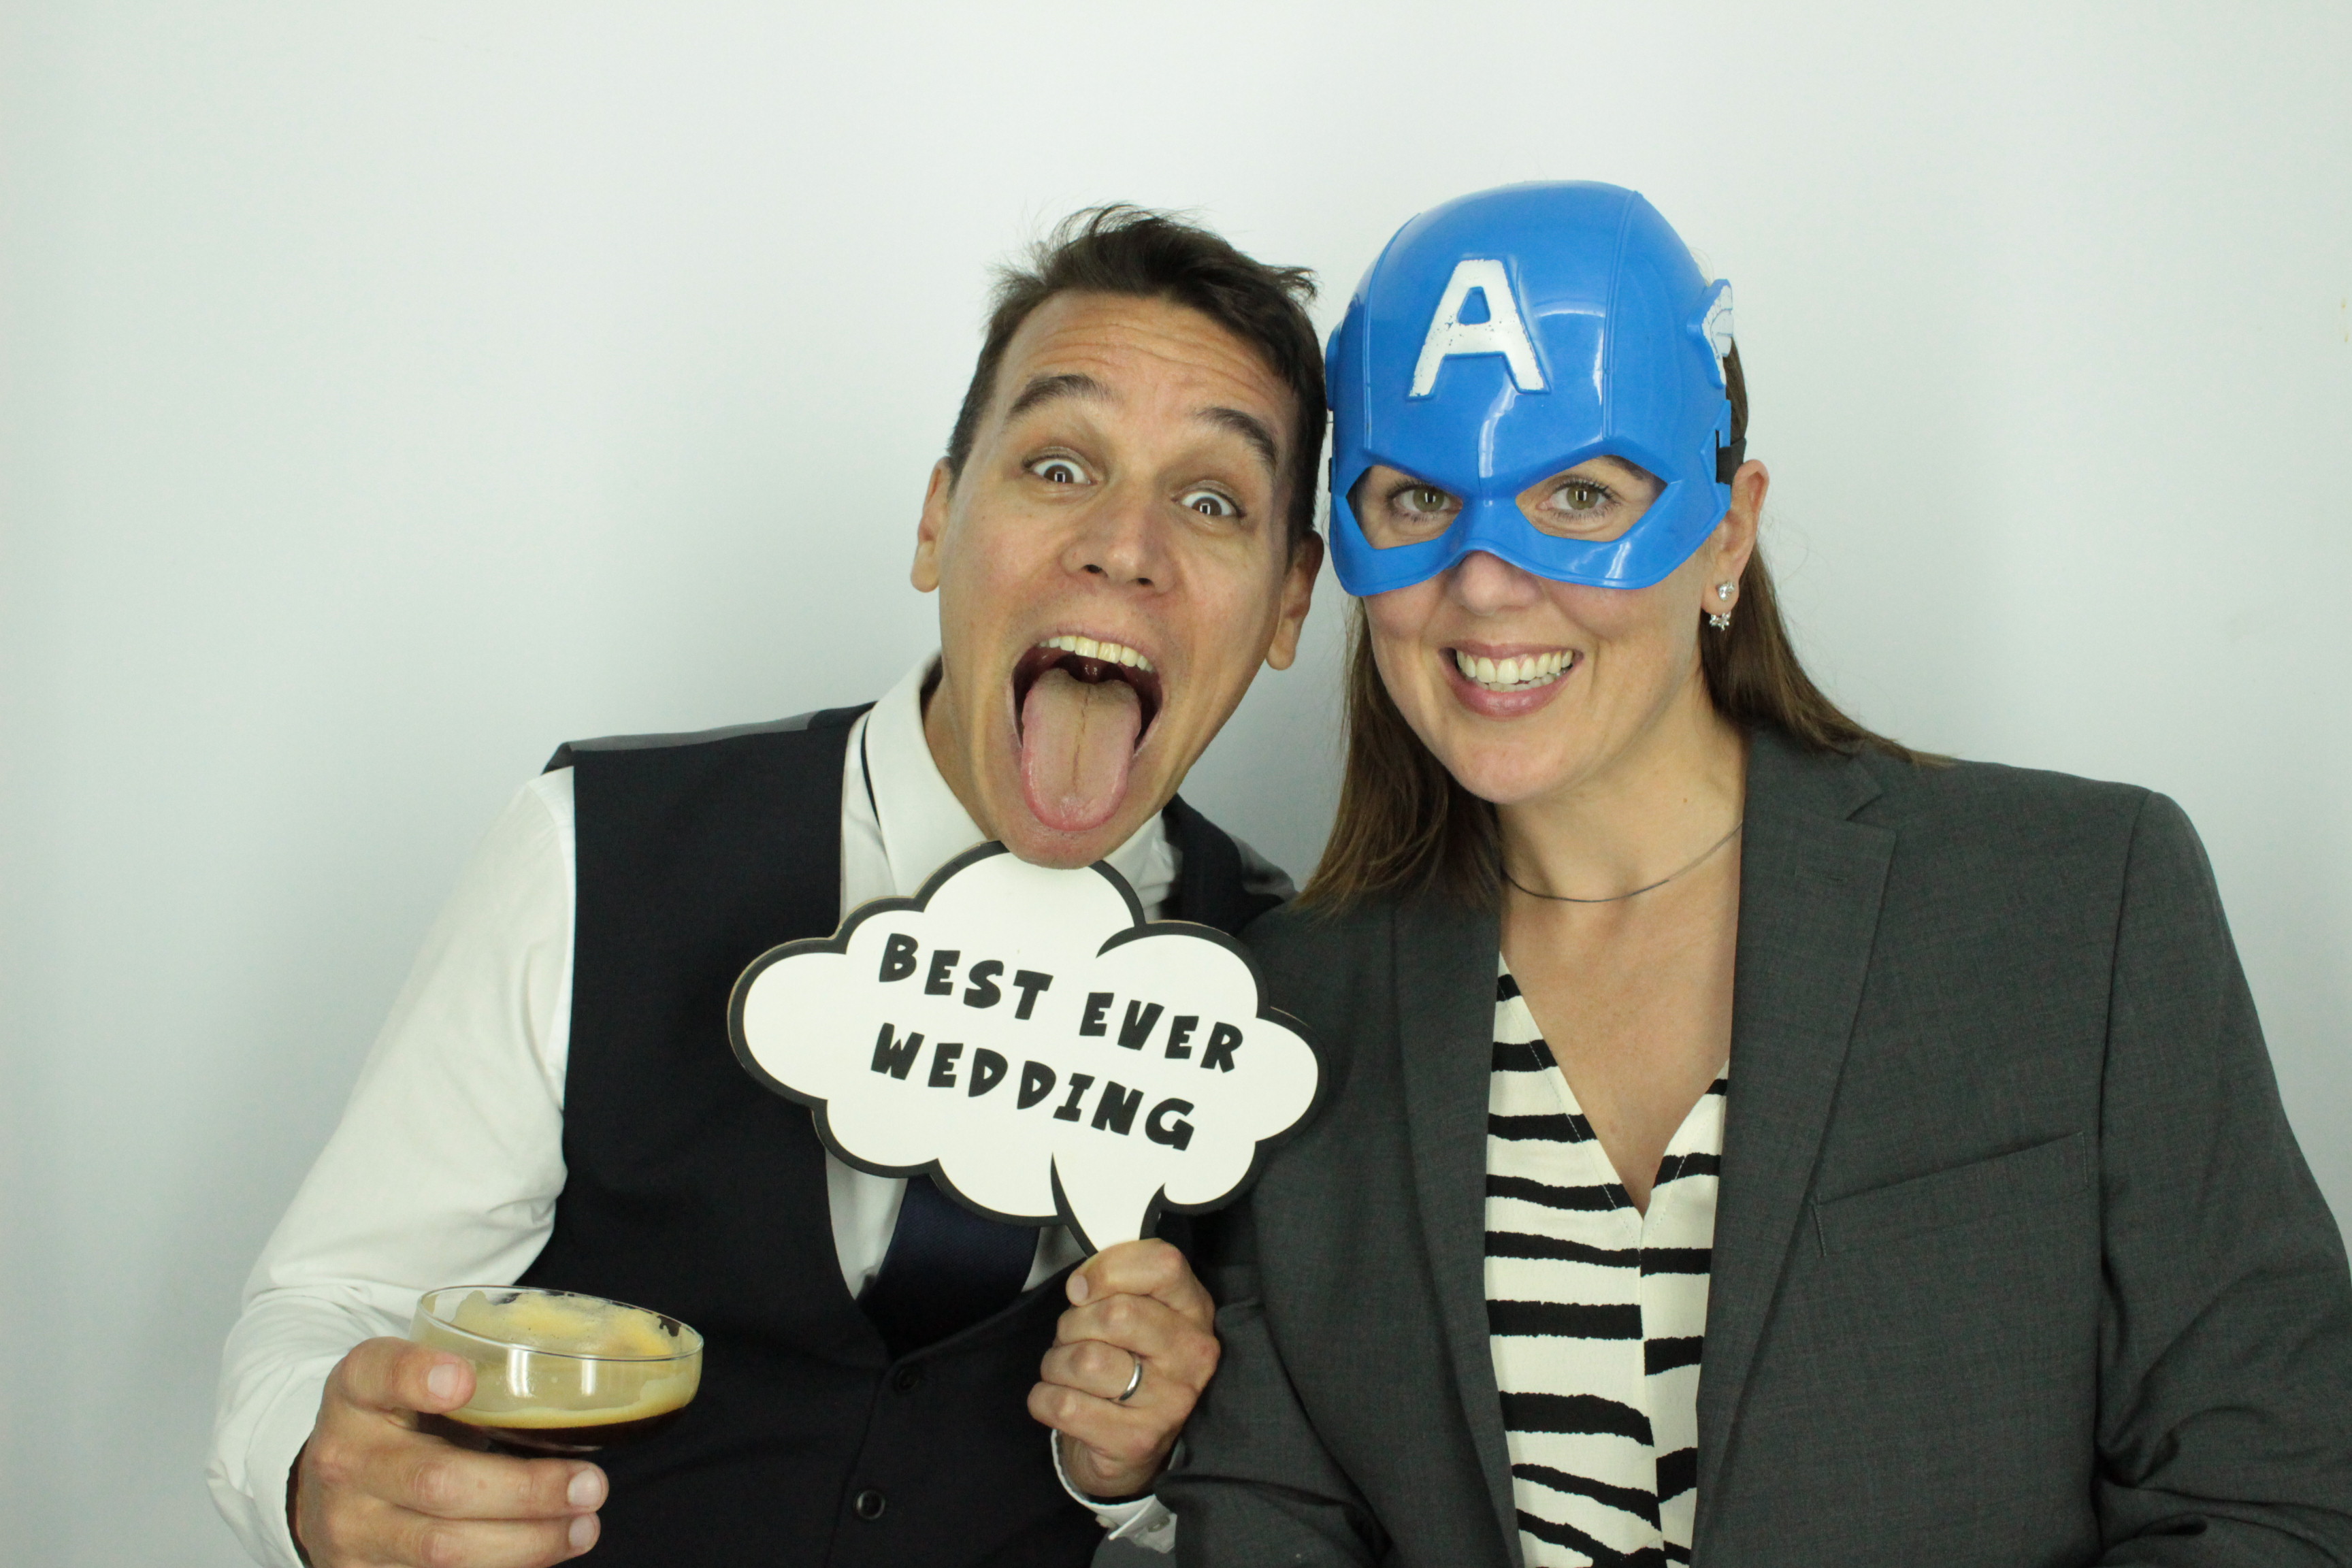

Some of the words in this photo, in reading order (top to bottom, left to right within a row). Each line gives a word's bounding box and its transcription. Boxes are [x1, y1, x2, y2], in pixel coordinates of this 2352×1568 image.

[1408, 259, 1546, 397] A
[879, 933, 1054, 1020] BEST
[1079, 992, 1243, 1073] EVER
[871, 1023, 1194, 1151] WEDDING
